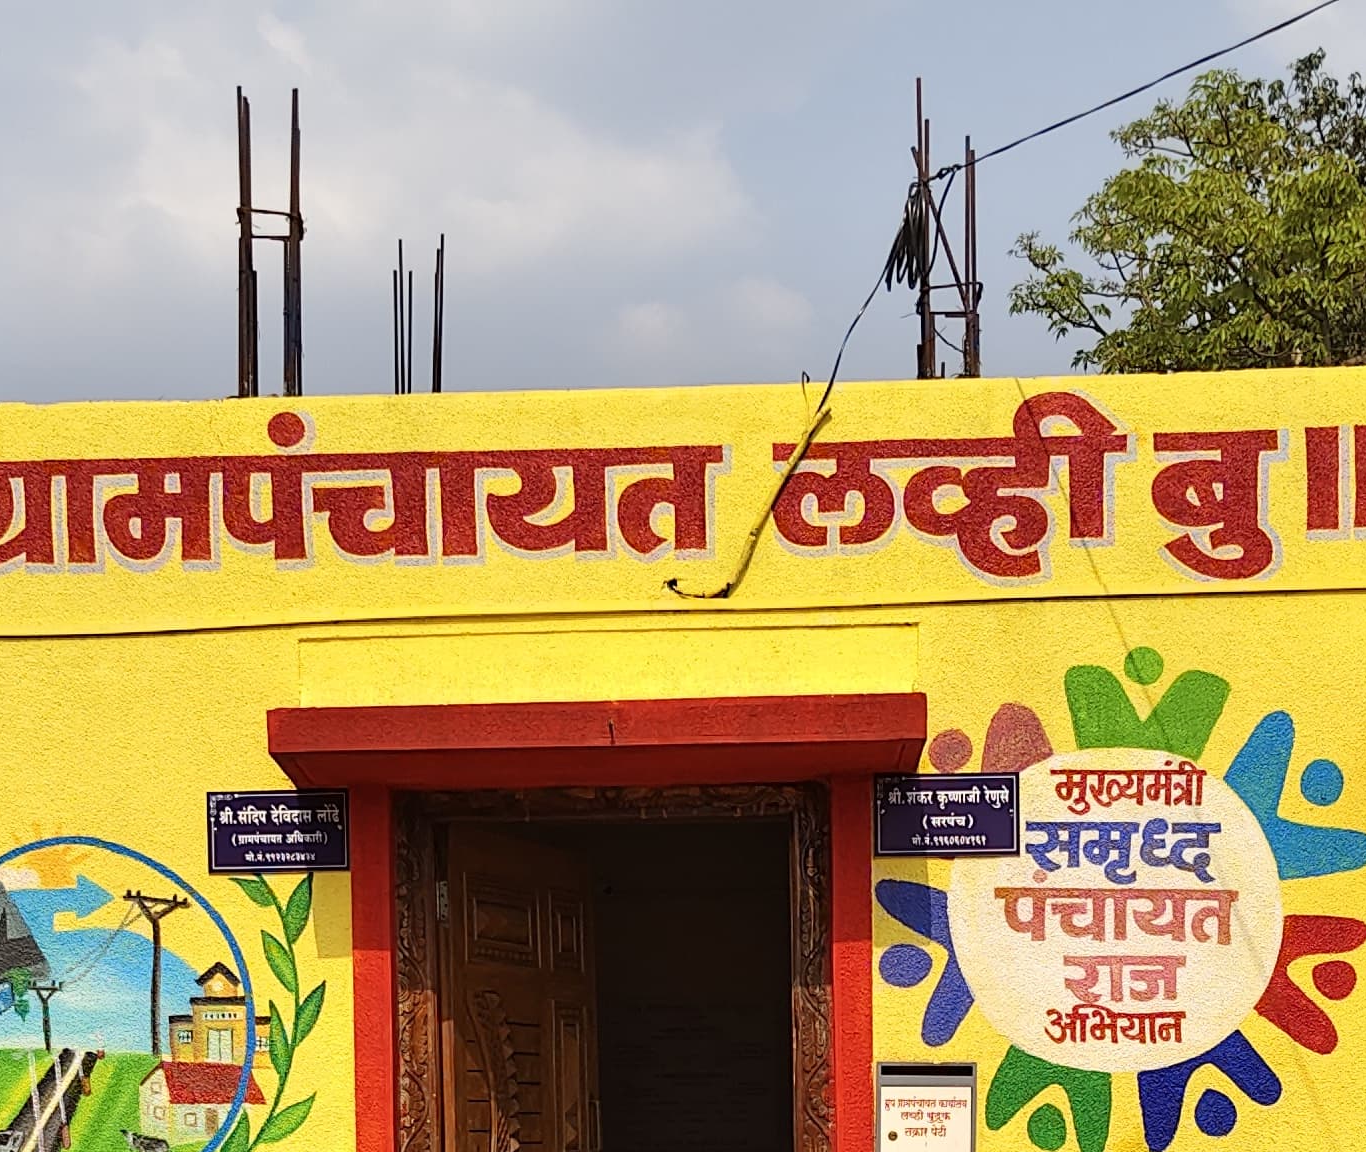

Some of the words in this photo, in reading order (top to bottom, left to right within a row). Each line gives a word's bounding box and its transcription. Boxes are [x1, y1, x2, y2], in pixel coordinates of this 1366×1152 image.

[772, 391, 1135, 586] लव्ही
[936, 785, 981, 810] कृष्णाजी
[1050, 760, 1207, 816] मुख्यमंत्री
[271, 803, 312, 826] देविदास
[994, 869, 1239, 945] पंचायत
[1063, 955, 1186, 1004] राज
[1044, 1004, 1186, 1044] अभियान
